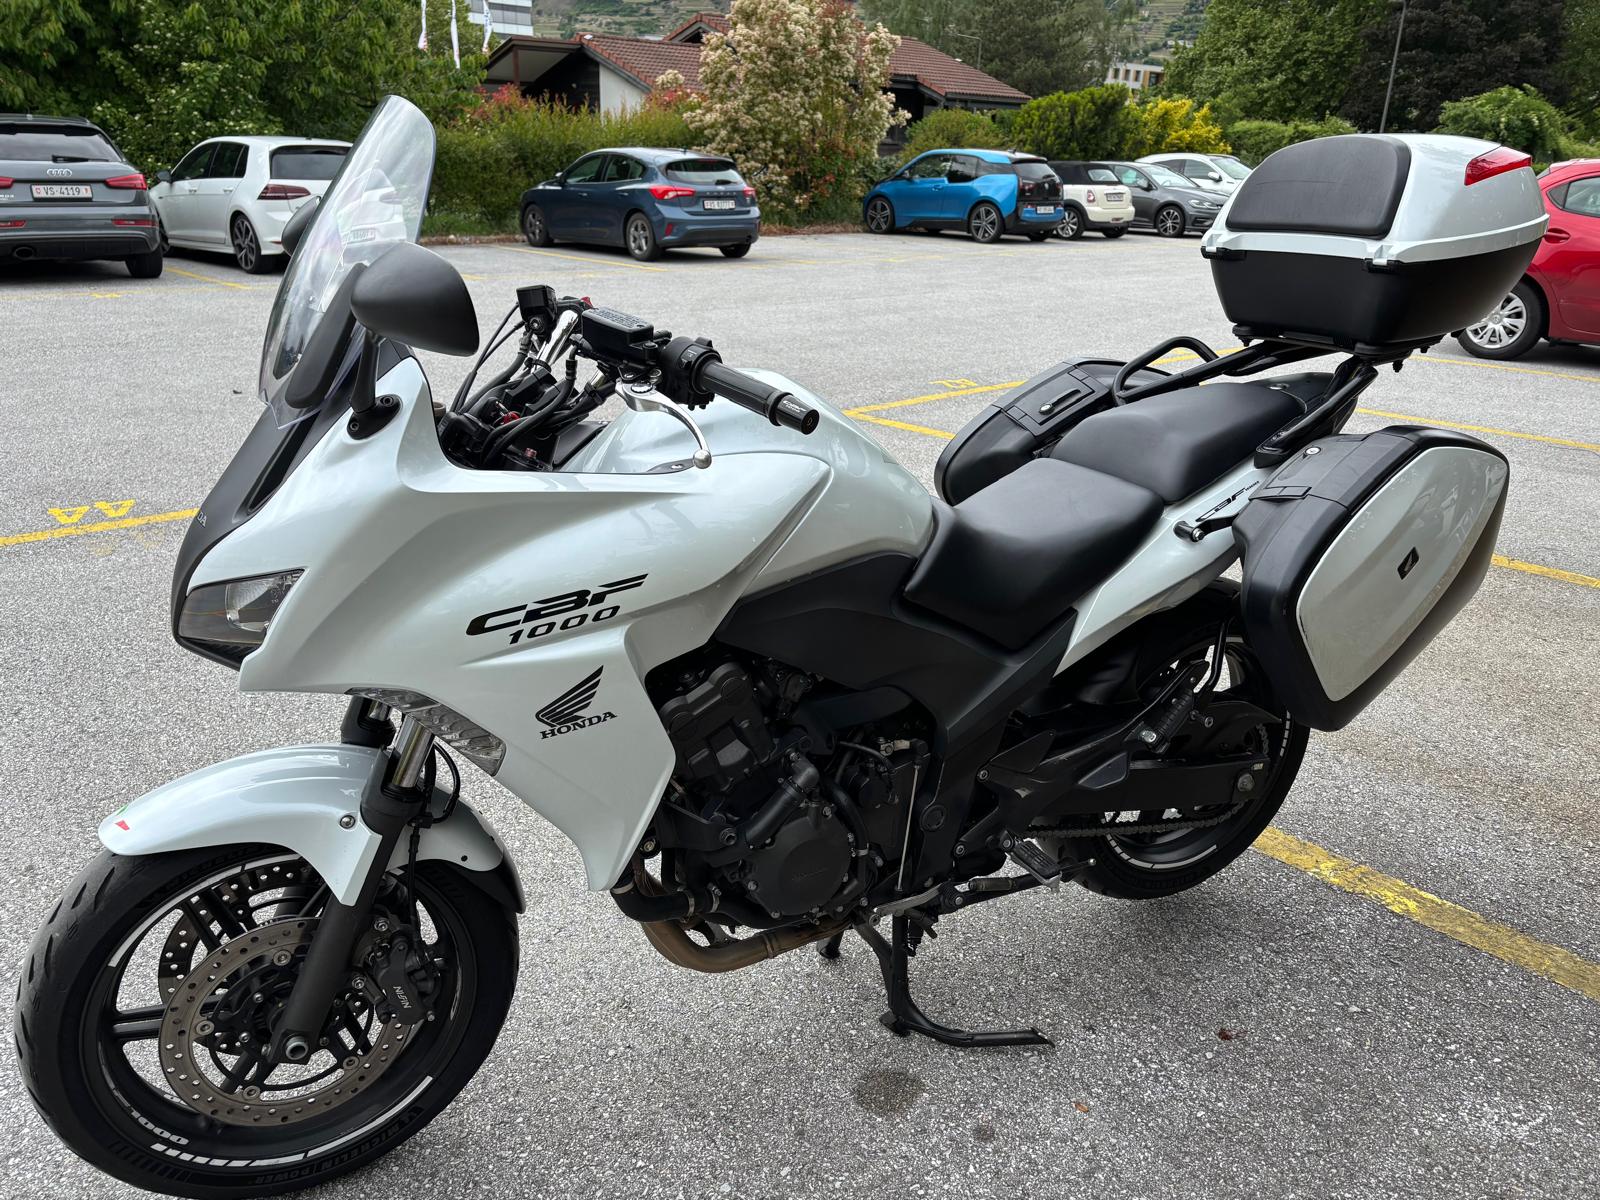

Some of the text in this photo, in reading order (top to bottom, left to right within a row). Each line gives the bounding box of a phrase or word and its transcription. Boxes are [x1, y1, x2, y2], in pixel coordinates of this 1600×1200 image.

[43, 186, 81, 196] VS 4119
[465, 573, 649, 636] CBF
[508, 605, 621, 645] 1000
[539, 711, 618, 740] HONDA
